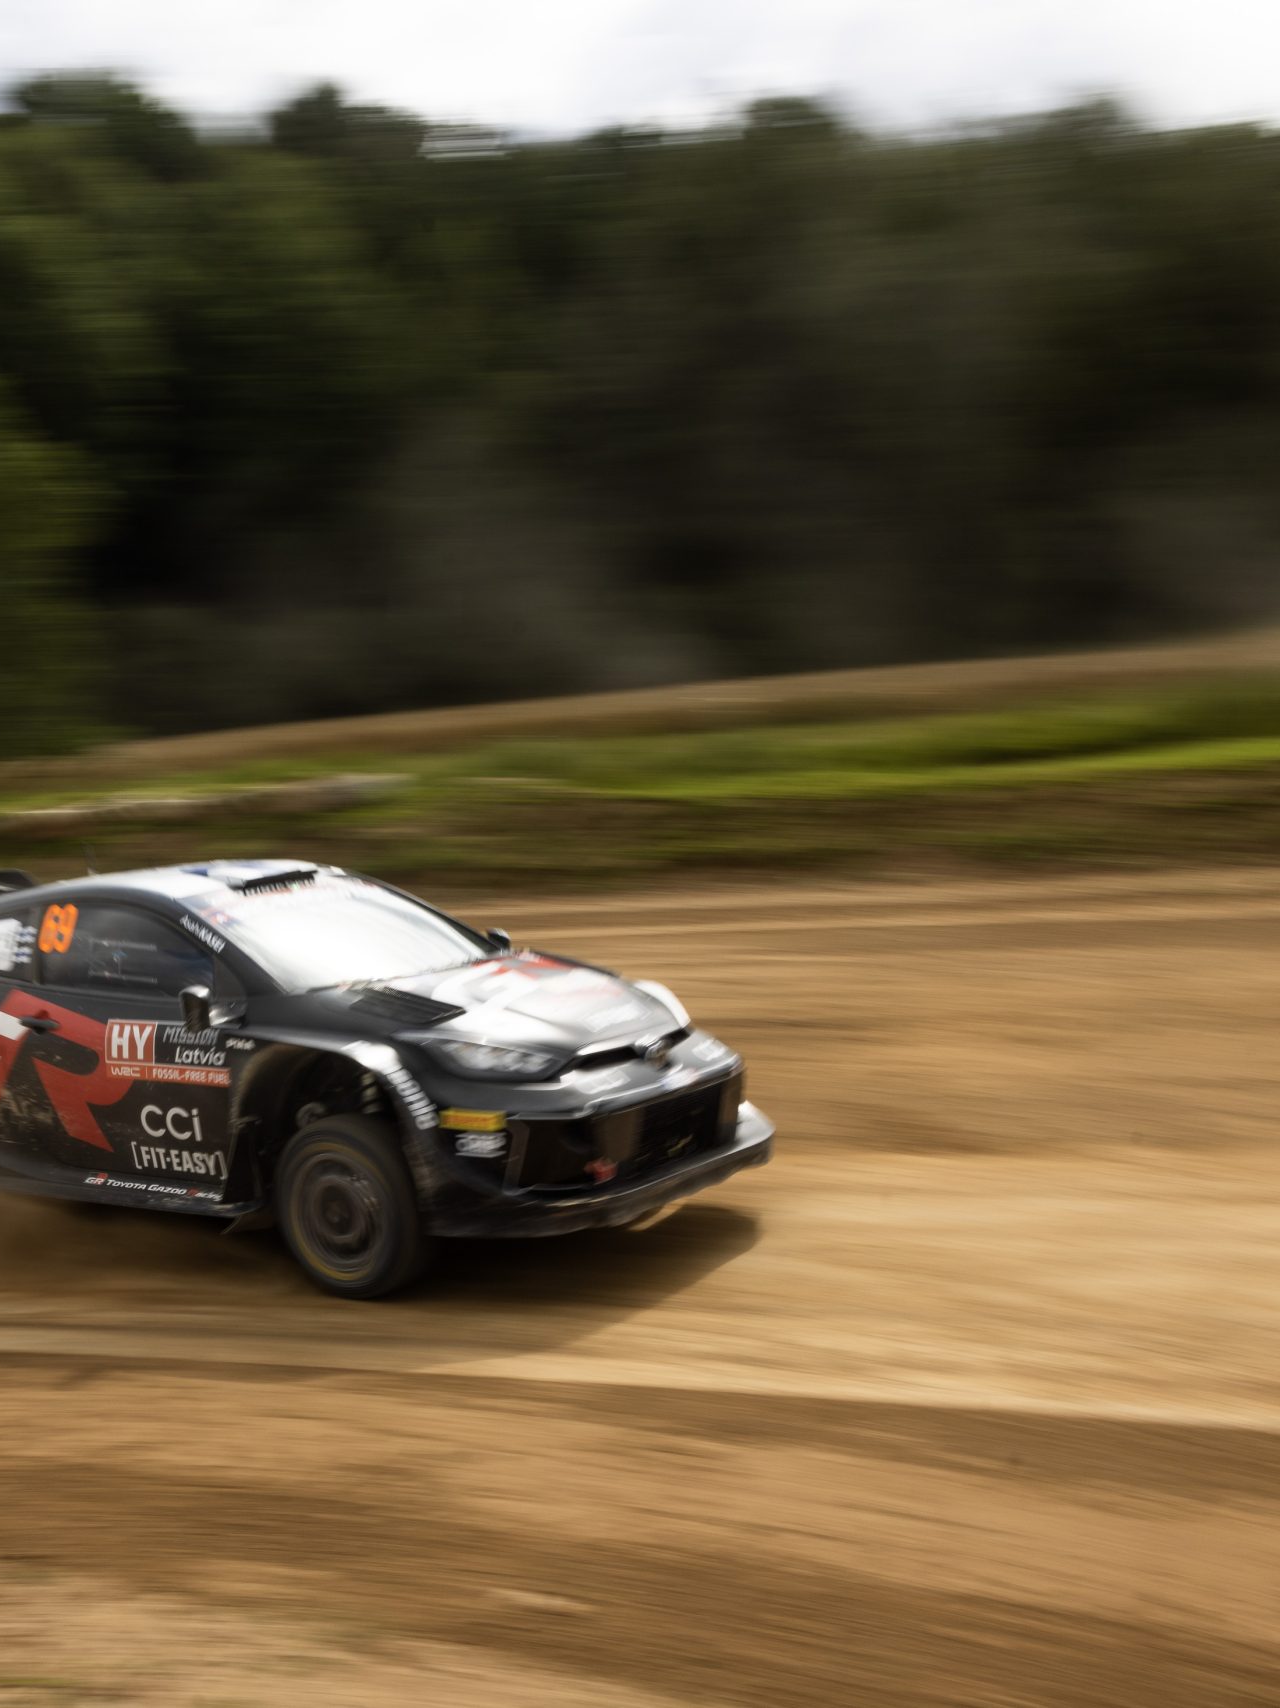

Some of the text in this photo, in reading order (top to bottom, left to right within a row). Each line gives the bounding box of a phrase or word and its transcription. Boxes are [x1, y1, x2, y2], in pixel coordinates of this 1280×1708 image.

[111, 1023, 153, 1061] HY
[174, 1046, 226, 1066] Latvia
[111, 1066, 141, 1077] WRC
[107, 1179, 147, 1190] TOYOTA
[148, 1184, 188, 1196] GAZOO
